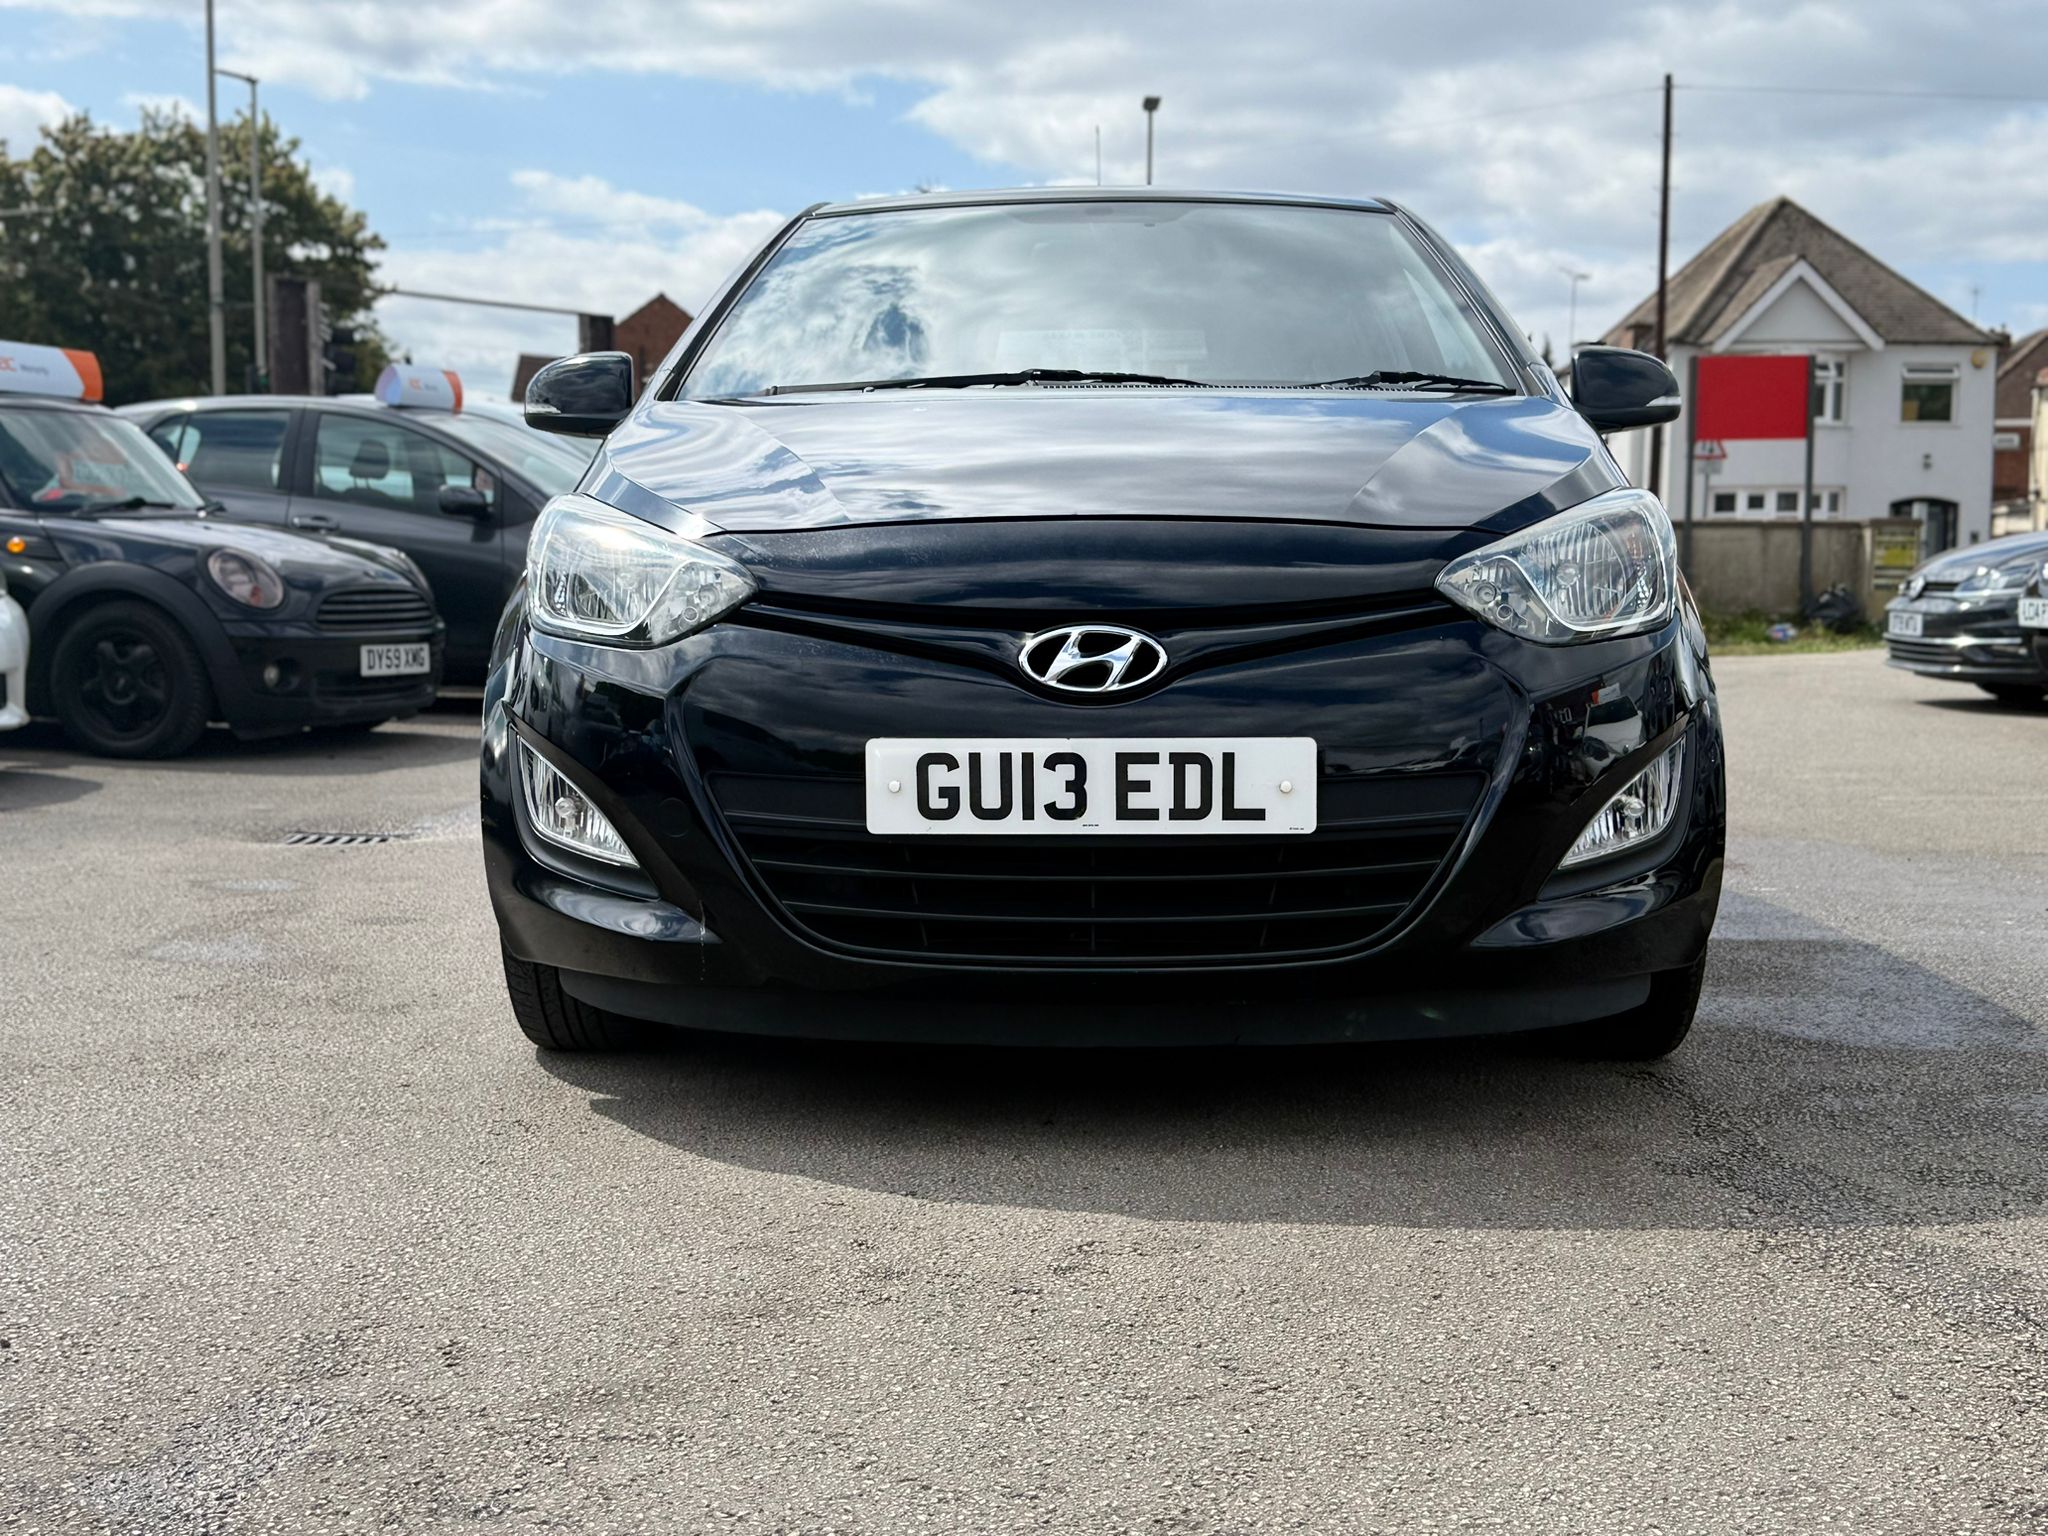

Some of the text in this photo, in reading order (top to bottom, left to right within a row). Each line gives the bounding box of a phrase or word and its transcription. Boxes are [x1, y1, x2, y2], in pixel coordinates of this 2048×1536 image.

[367, 648, 400, 670] DY59
[916, 752, 1266, 821] GU13 EDL
